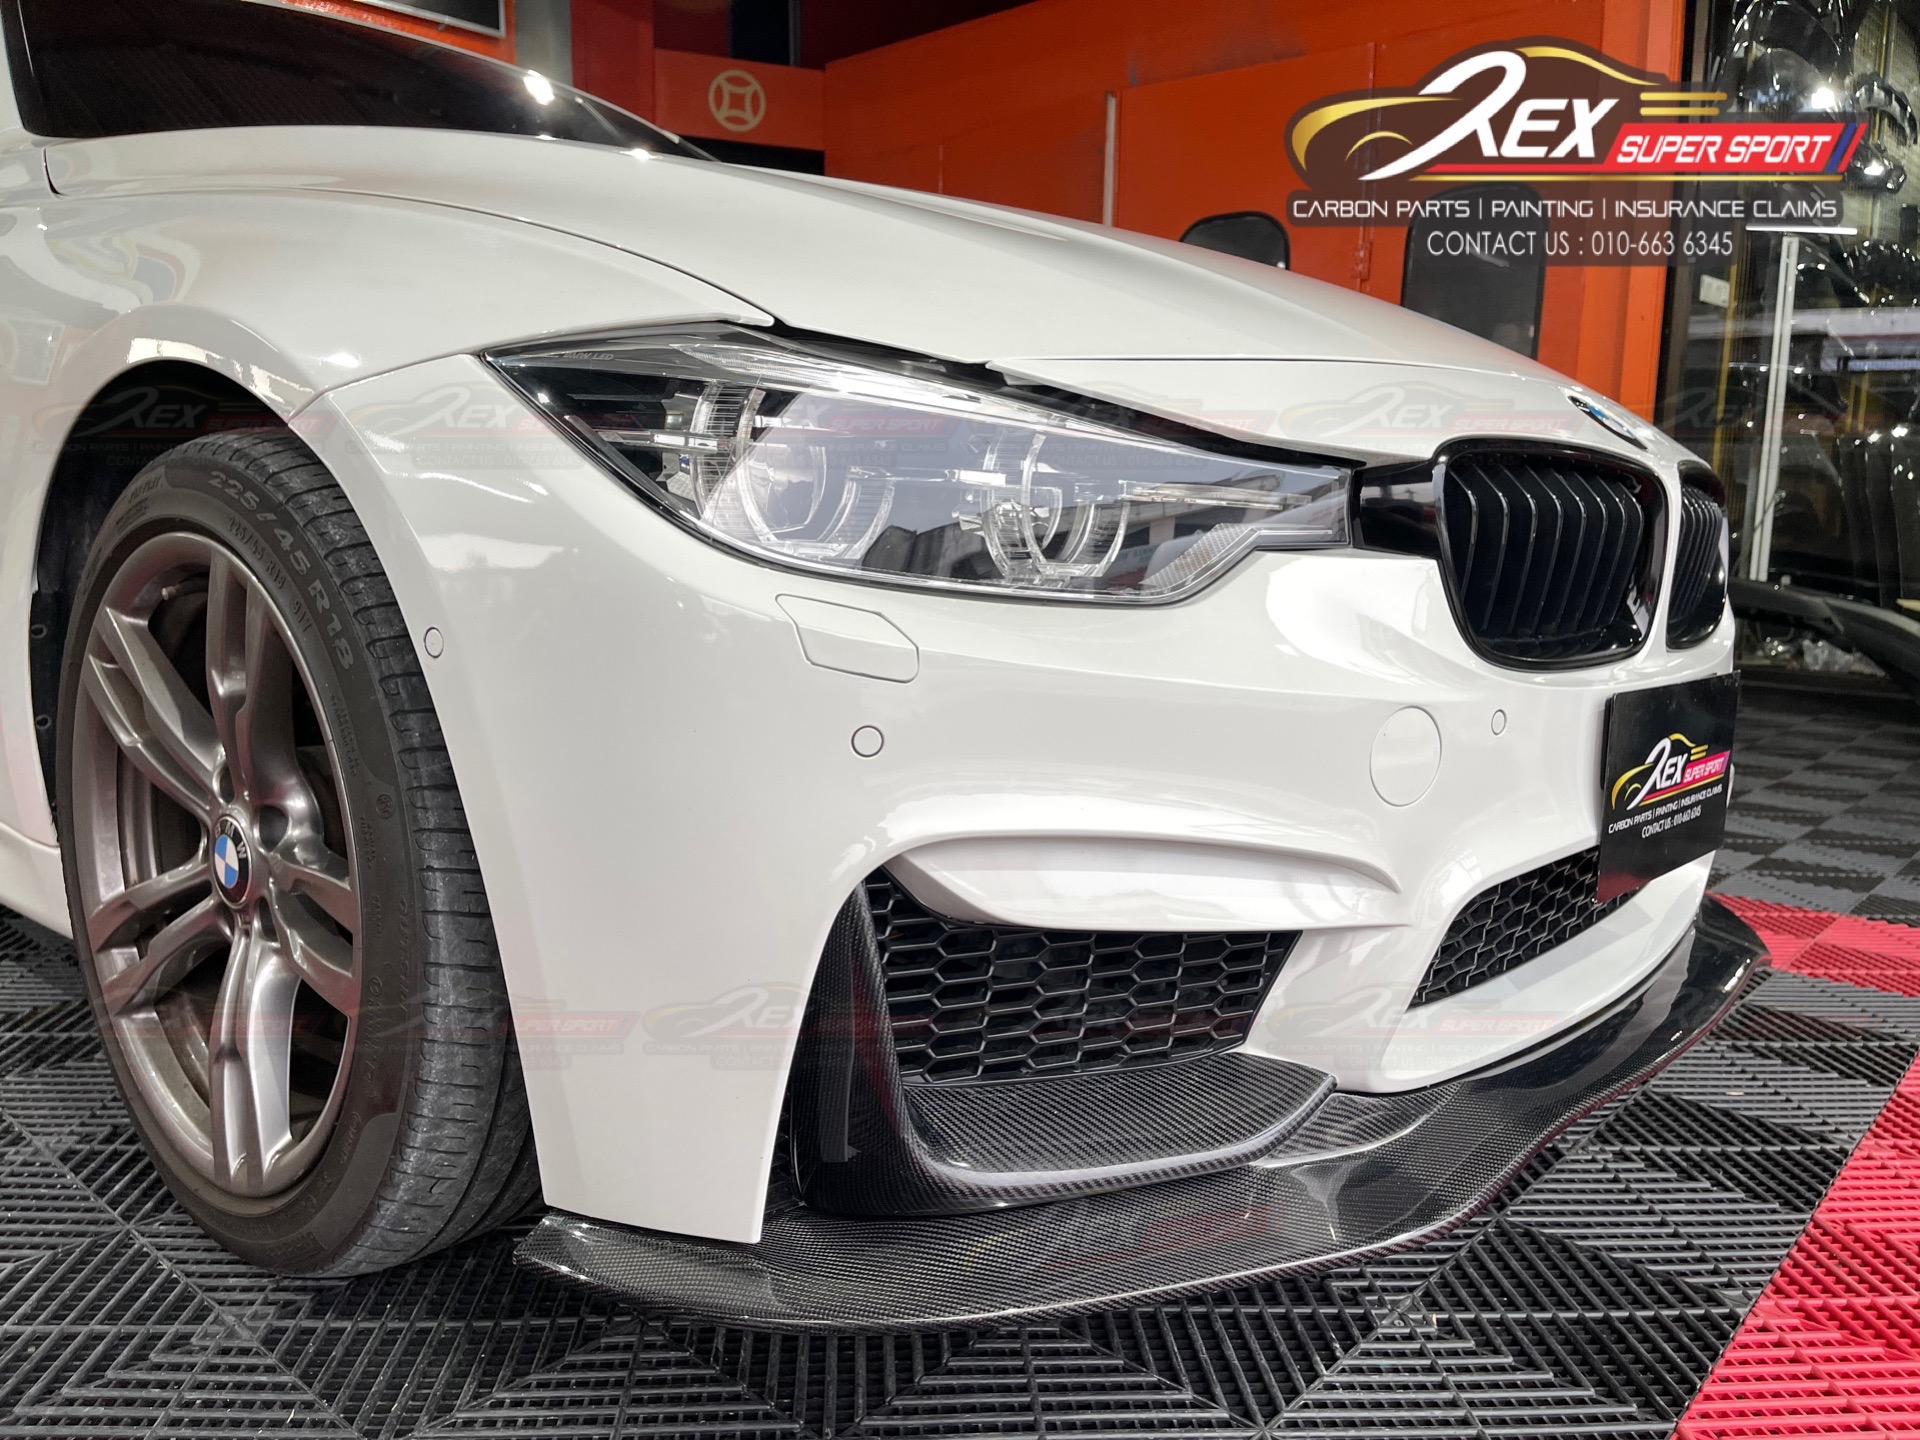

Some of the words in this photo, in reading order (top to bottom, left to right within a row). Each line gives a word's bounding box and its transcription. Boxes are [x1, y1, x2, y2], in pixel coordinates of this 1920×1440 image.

[563, 352, 592, 360] BMW
[592, 353, 614, 361] LED
[208, 470, 311, 576] 225/45
[308, 579, 354, 670] R18
[1627, 737, 1688, 811] REX
[1684, 764, 1706, 784] SUPER
[1705, 757, 1725, 779] SPORT
[1608, 816, 1633, 834] CARBON
[1633, 811, 1653, 826] PARTS
[1655, 803, 1679, 819] PAINTING
[1681, 791, 1706, 809] INSURANCE
[1706, 784, 1723, 799] CLAIMS
[215, 822, 247, 858] BMW
[1641, 821, 1665, 839] CONTACT
